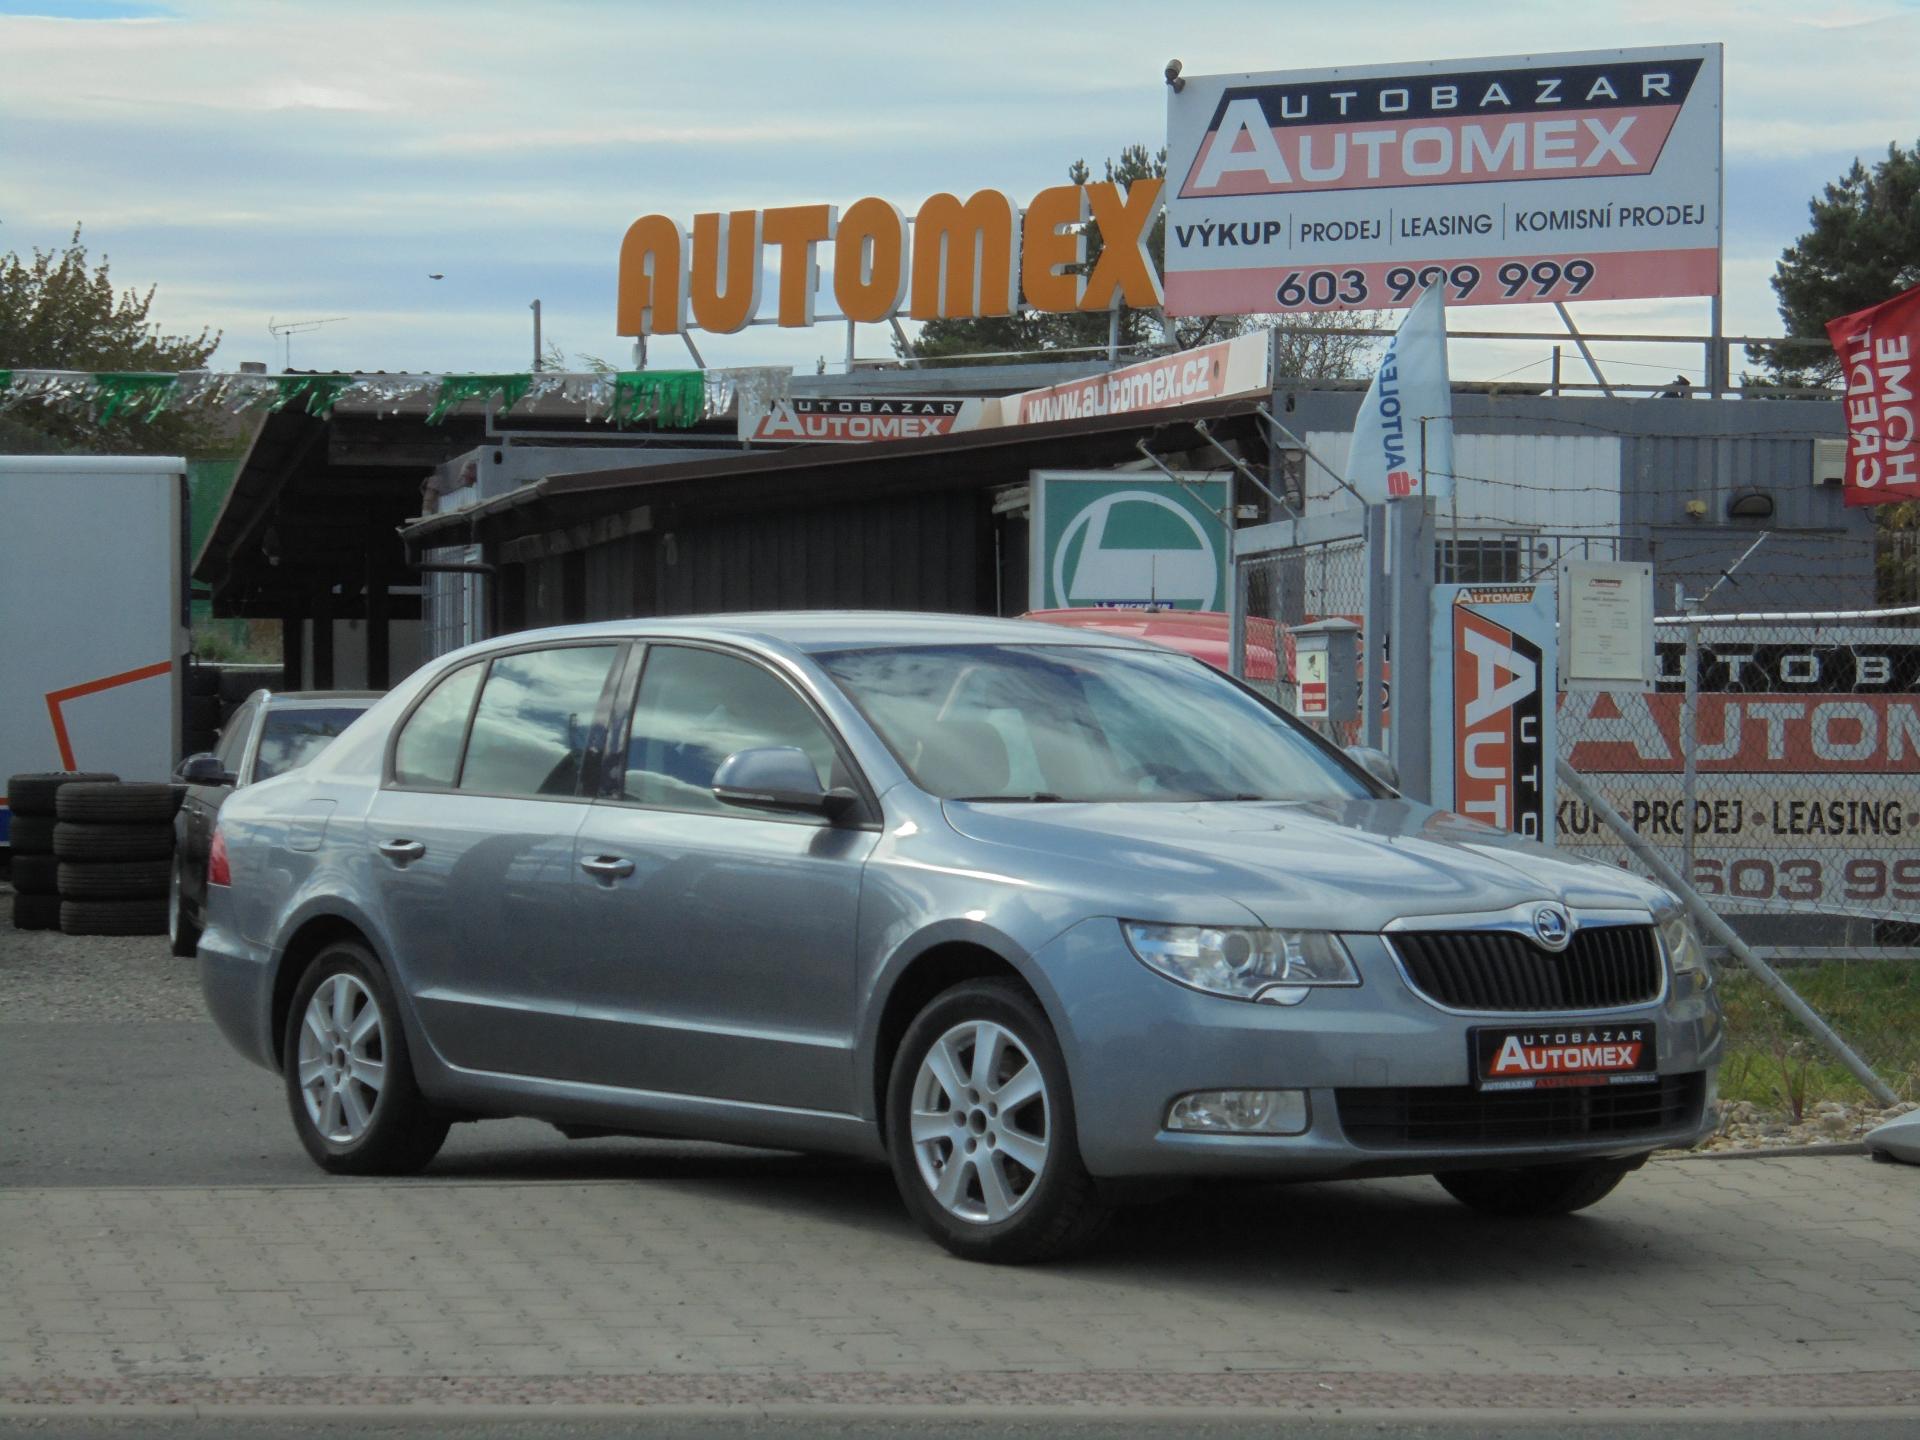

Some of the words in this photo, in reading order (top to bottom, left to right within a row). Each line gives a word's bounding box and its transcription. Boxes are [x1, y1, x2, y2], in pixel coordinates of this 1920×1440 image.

[1193, 98, 1638, 189] AUTOMEX
[1175, 219, 1282, 248] VÝKUP
[1300, 219, 1382, 244] PRODEJ
[1401, 213, 1493, 238] LEASING
[1515, 202, 1614, 233] KOMISNÍ
[1619, 204, 1706, 228] PRODEJ
[616, 178, 1166, 337] AUTOMEX
[1276, 269, 1369, 307] 603
[1497, 258, 1596, 298] 999
[1028, 354, 1210, 424] www.automex.cz
[762, 400, 945, 437] AUTOMEX
[1455, 588, 1529, 603] AUTOMEX
[1772, 800, 1901, 835] LEASING
[1496, 1035, 1634, 1072] AUTOMEX
